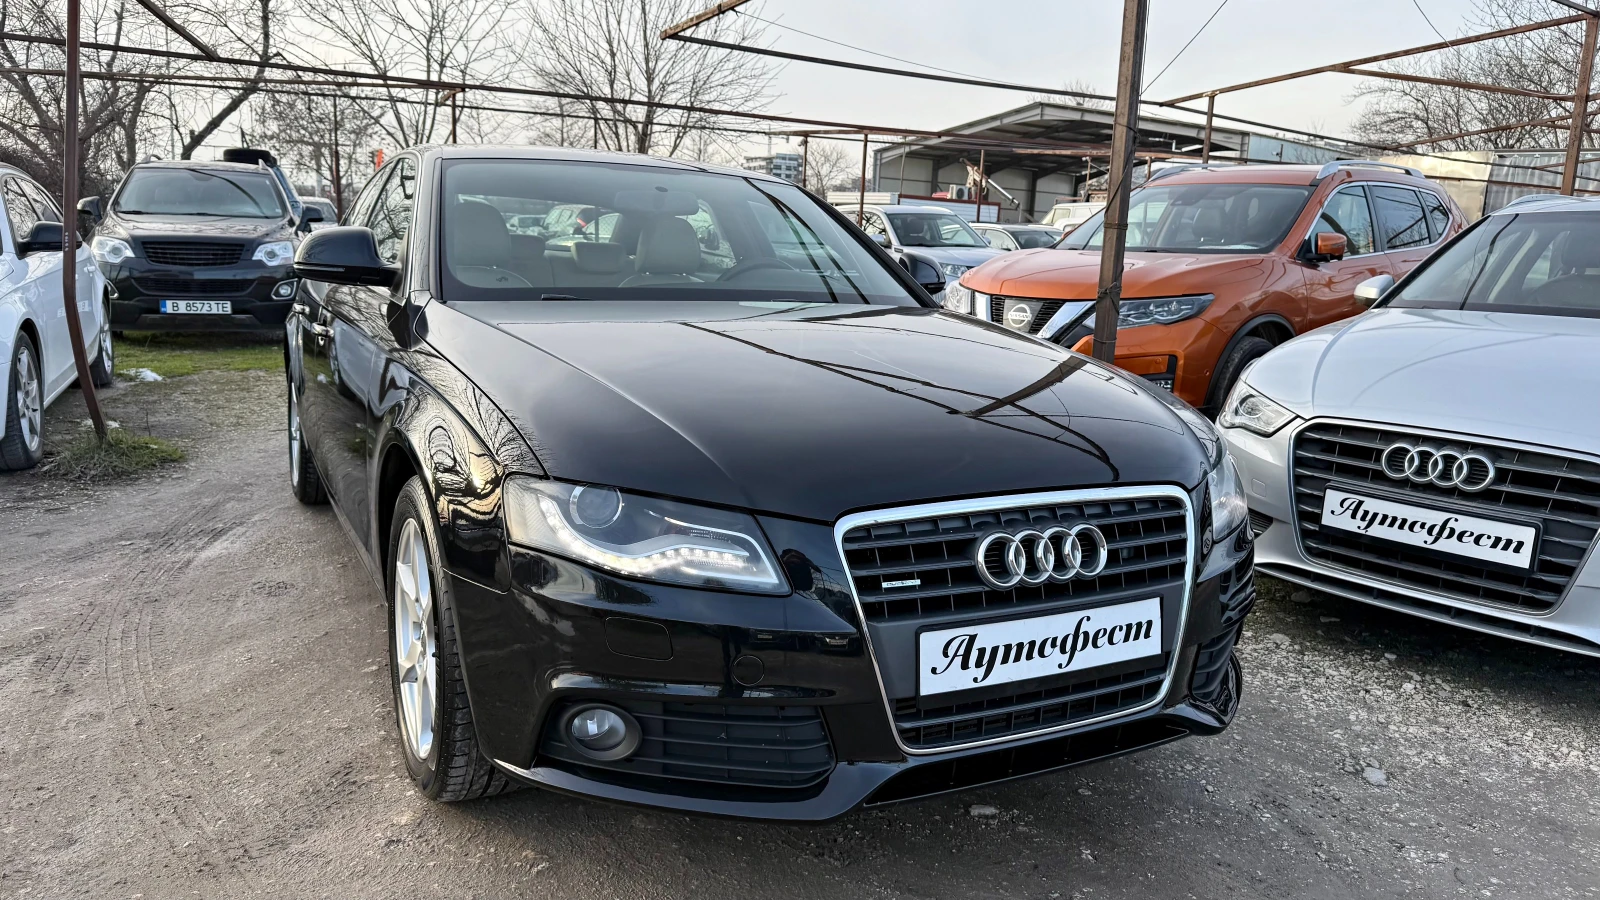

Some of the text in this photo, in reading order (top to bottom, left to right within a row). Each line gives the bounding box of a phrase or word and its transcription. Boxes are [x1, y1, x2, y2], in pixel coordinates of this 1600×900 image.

[172, 302, 229, 312] B 8573 TE
[1330, 497, 1525, 554] Аутофест
[931, 616, 1153, 683] Аутофест
